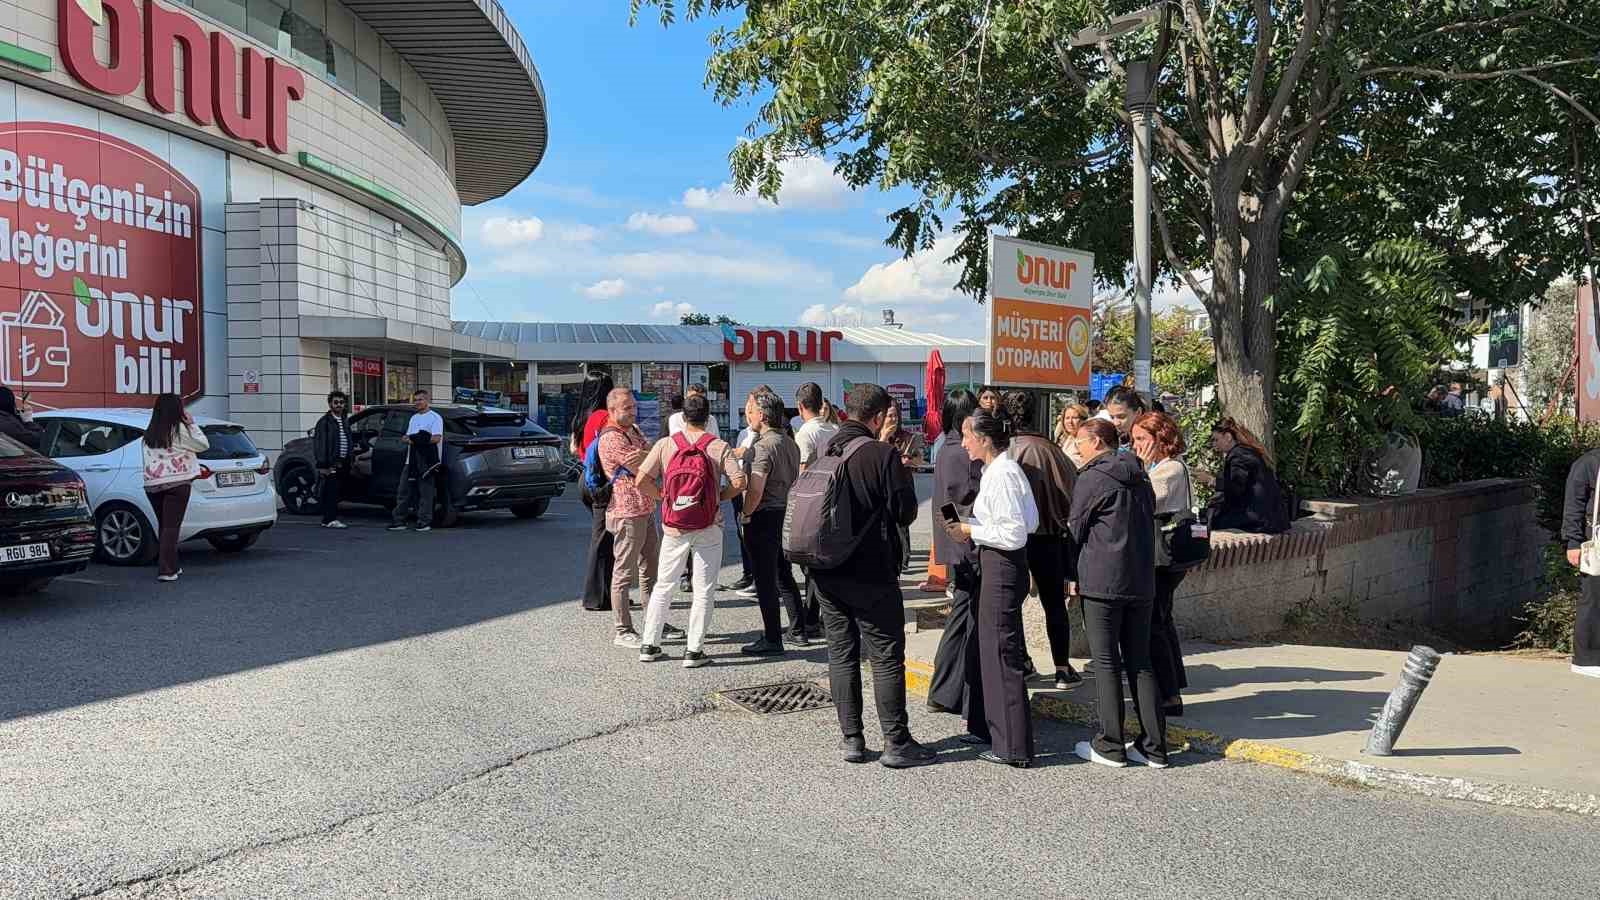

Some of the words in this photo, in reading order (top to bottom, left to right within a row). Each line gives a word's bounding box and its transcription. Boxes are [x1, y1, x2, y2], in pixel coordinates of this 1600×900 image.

[0, 149, 191, 239] Bütçenizin
[997, 311, 1064, 343] MÜŞTERİ
[115, 344, 186, 394] bilir
[996, 347, 1063, 370] OTOPARKI
[676, 495, 697, 505] NIKE
[29, 544, 47, 557] 984
